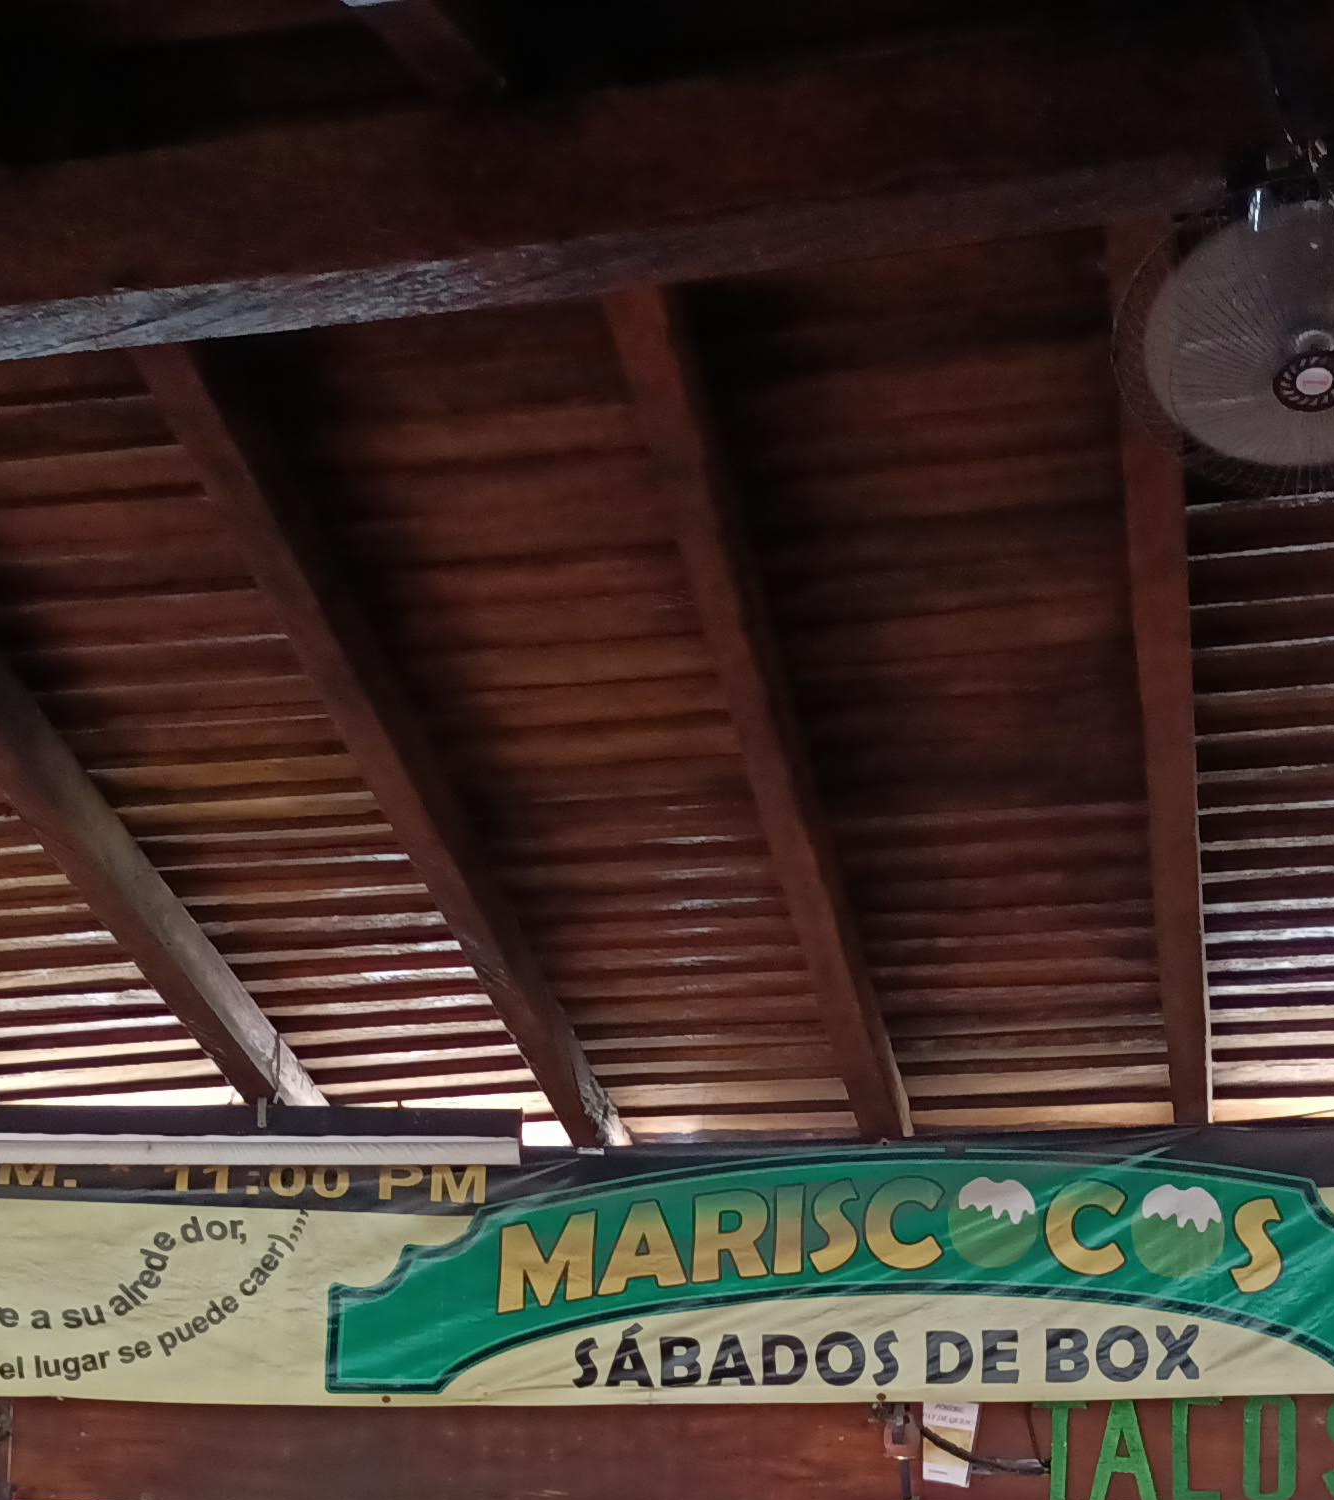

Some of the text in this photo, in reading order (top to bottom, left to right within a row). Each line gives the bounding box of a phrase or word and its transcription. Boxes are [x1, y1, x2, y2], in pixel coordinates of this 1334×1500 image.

[378, 1164, 487, 1204] PM
[0, 1355, 25, 1380] el
[34, 1348, 111, 1381] lugar
[117, 1344, 152, 1364] se
[157, 1293, 240, 1358] puede
[30, 1308, 52, 1330] a
[62, 1303, 106, 1329] su
[572, 1322, 1201, 1389] SÁBADOS DE BOX
